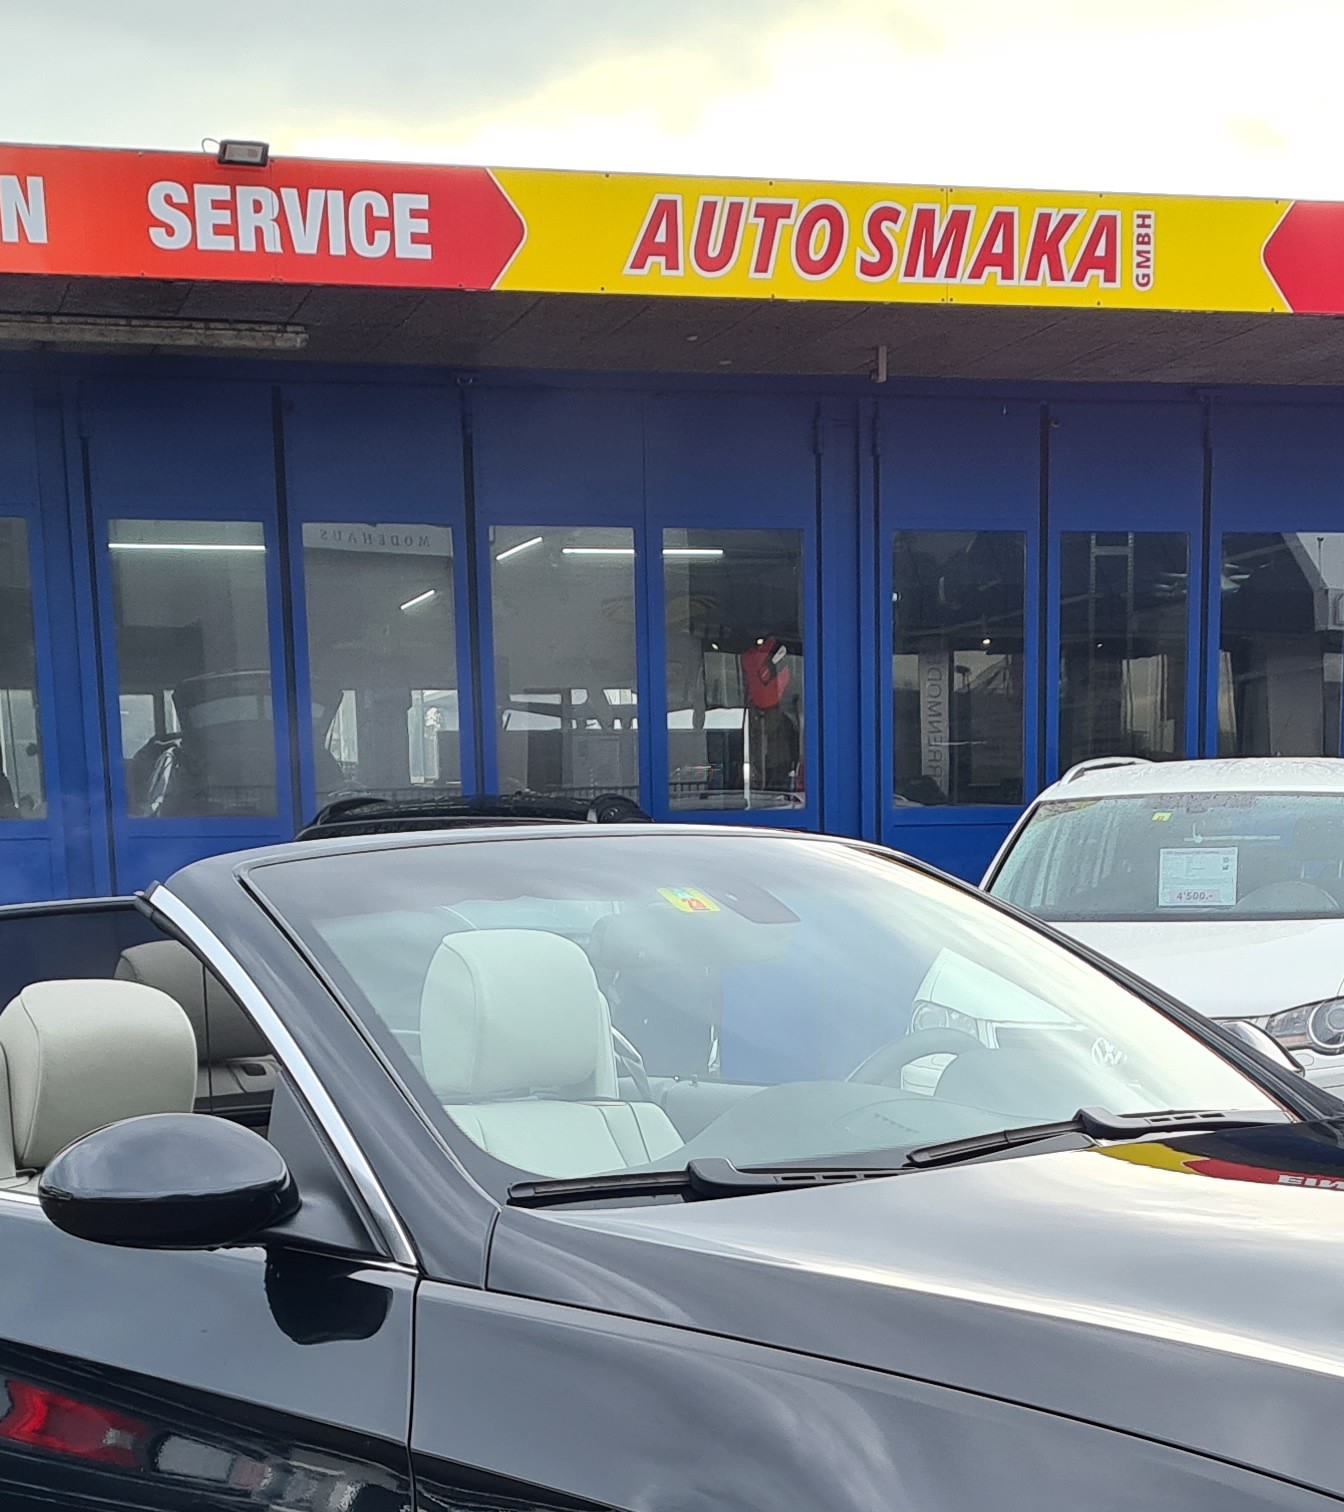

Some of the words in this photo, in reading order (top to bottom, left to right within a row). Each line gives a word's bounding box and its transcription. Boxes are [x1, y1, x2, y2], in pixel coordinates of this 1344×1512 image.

[147, 181, 432, 260] SERVICE
[630, 199, 845, 277] AUTO
[858, 205, 1118, 284] SMAKA
[1136, 214, 1152, 288] GMBH
